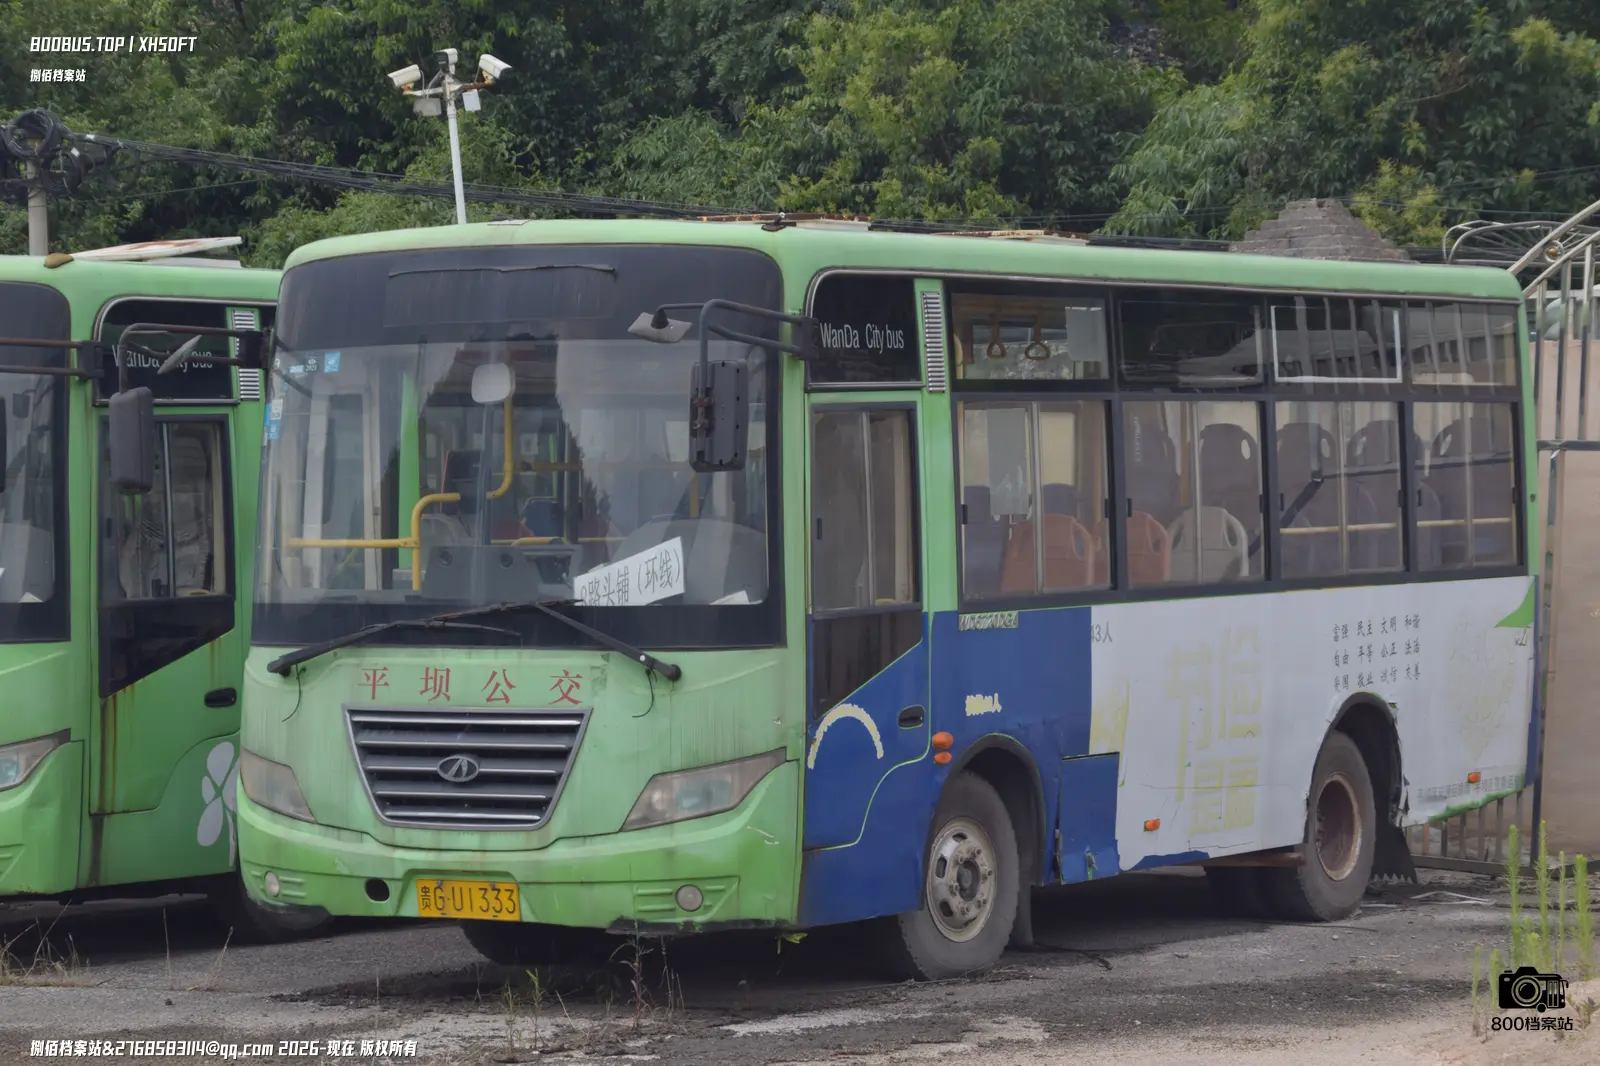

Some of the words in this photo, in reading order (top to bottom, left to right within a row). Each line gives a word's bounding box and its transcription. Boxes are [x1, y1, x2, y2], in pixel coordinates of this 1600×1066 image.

[819, 322, 860, 349] WanDa
[865, 323, 885, 354] City
[886, 324, 905, 349] bus
[1357, 620, 1373, 637] 民主
[1333, 648, 1349, 667] 自由
